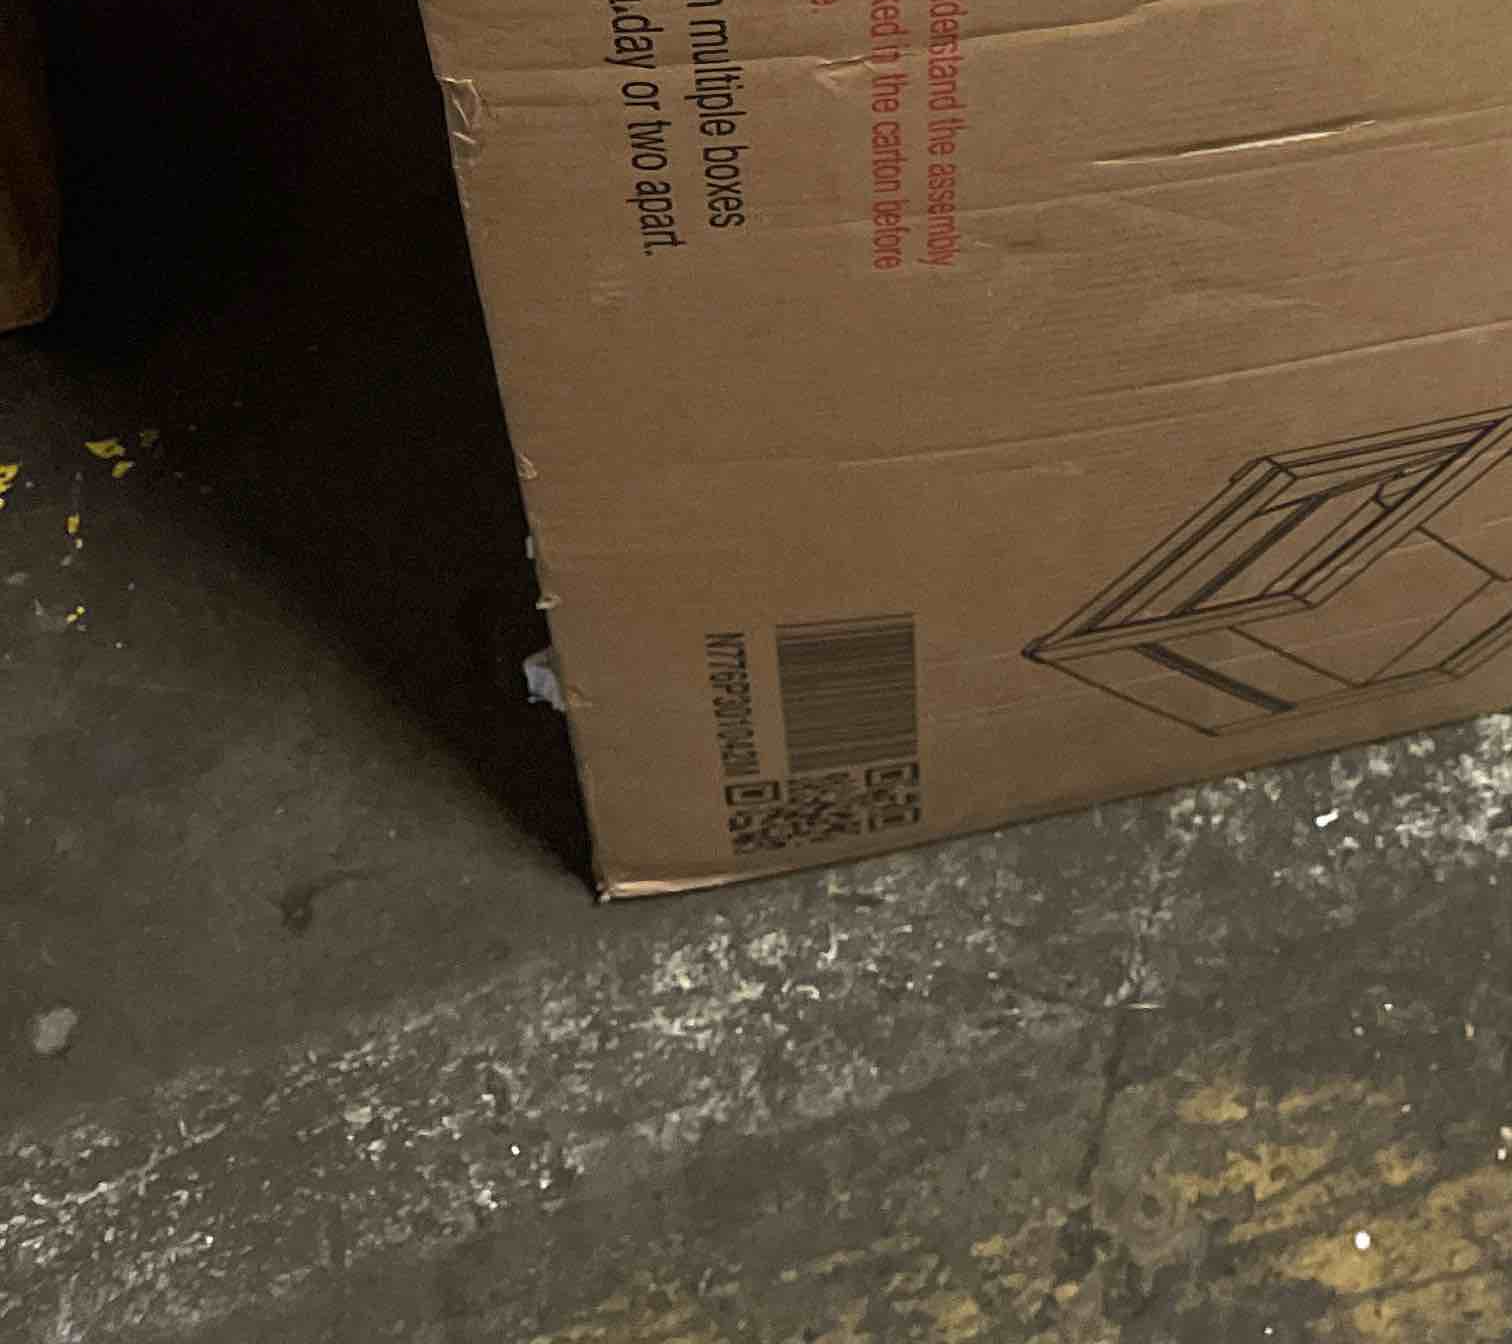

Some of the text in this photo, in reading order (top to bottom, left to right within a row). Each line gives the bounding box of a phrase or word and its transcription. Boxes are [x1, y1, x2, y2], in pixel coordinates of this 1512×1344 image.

[683, 17, 748, 139] multiple
[869, 41, 906, 67] in
[620, 79, 663, 113] or
[870, 71, 911, 115] the
[626, 118, 673, 172] two
[870, 117, 906, 200] carton
[926, 116, 969, 158] the
[627, 179, 688, 258] apart.
[700, 144, 751, 231] boxes
[916, 163, 965, 269] assembly
[870, 203, 906, 273] before
